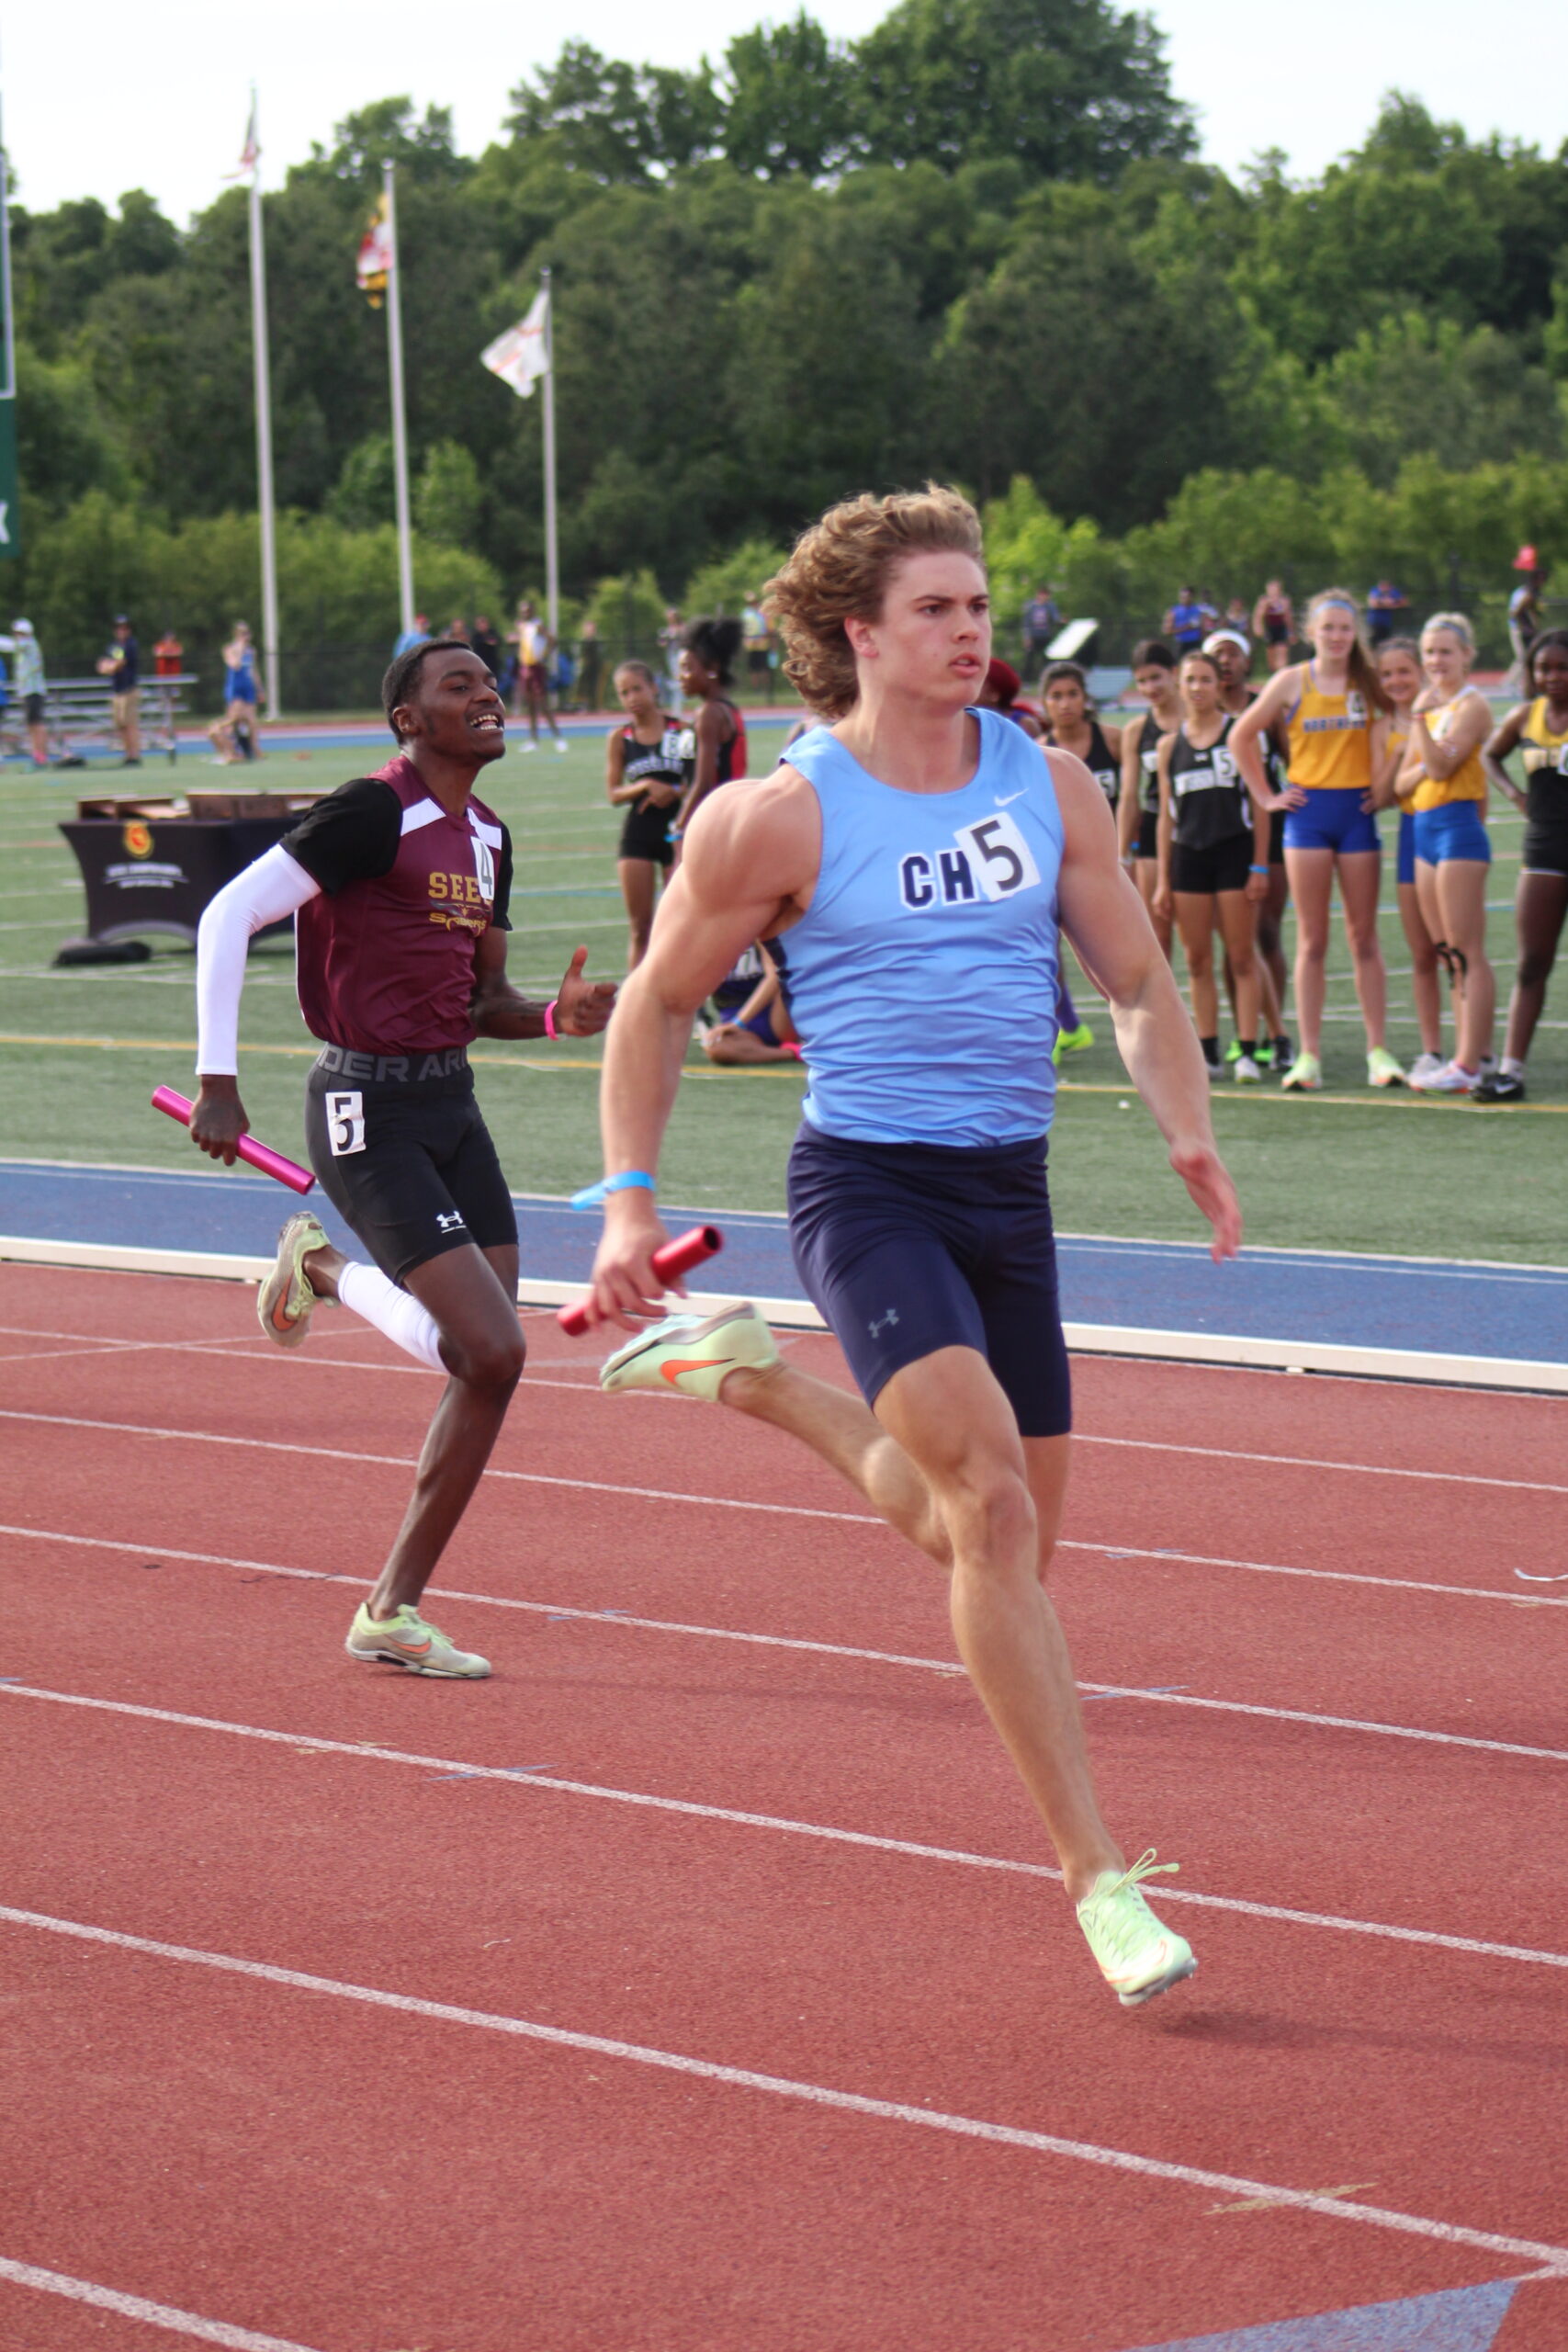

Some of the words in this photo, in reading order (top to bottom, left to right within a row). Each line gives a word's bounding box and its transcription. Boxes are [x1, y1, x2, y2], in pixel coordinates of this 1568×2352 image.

[479, 842, 493, 897] 4
[970, 820, 1024, 892] 5
[427, 871, 493, 905] SEE
[334, 1097, 355, 1152] 5
